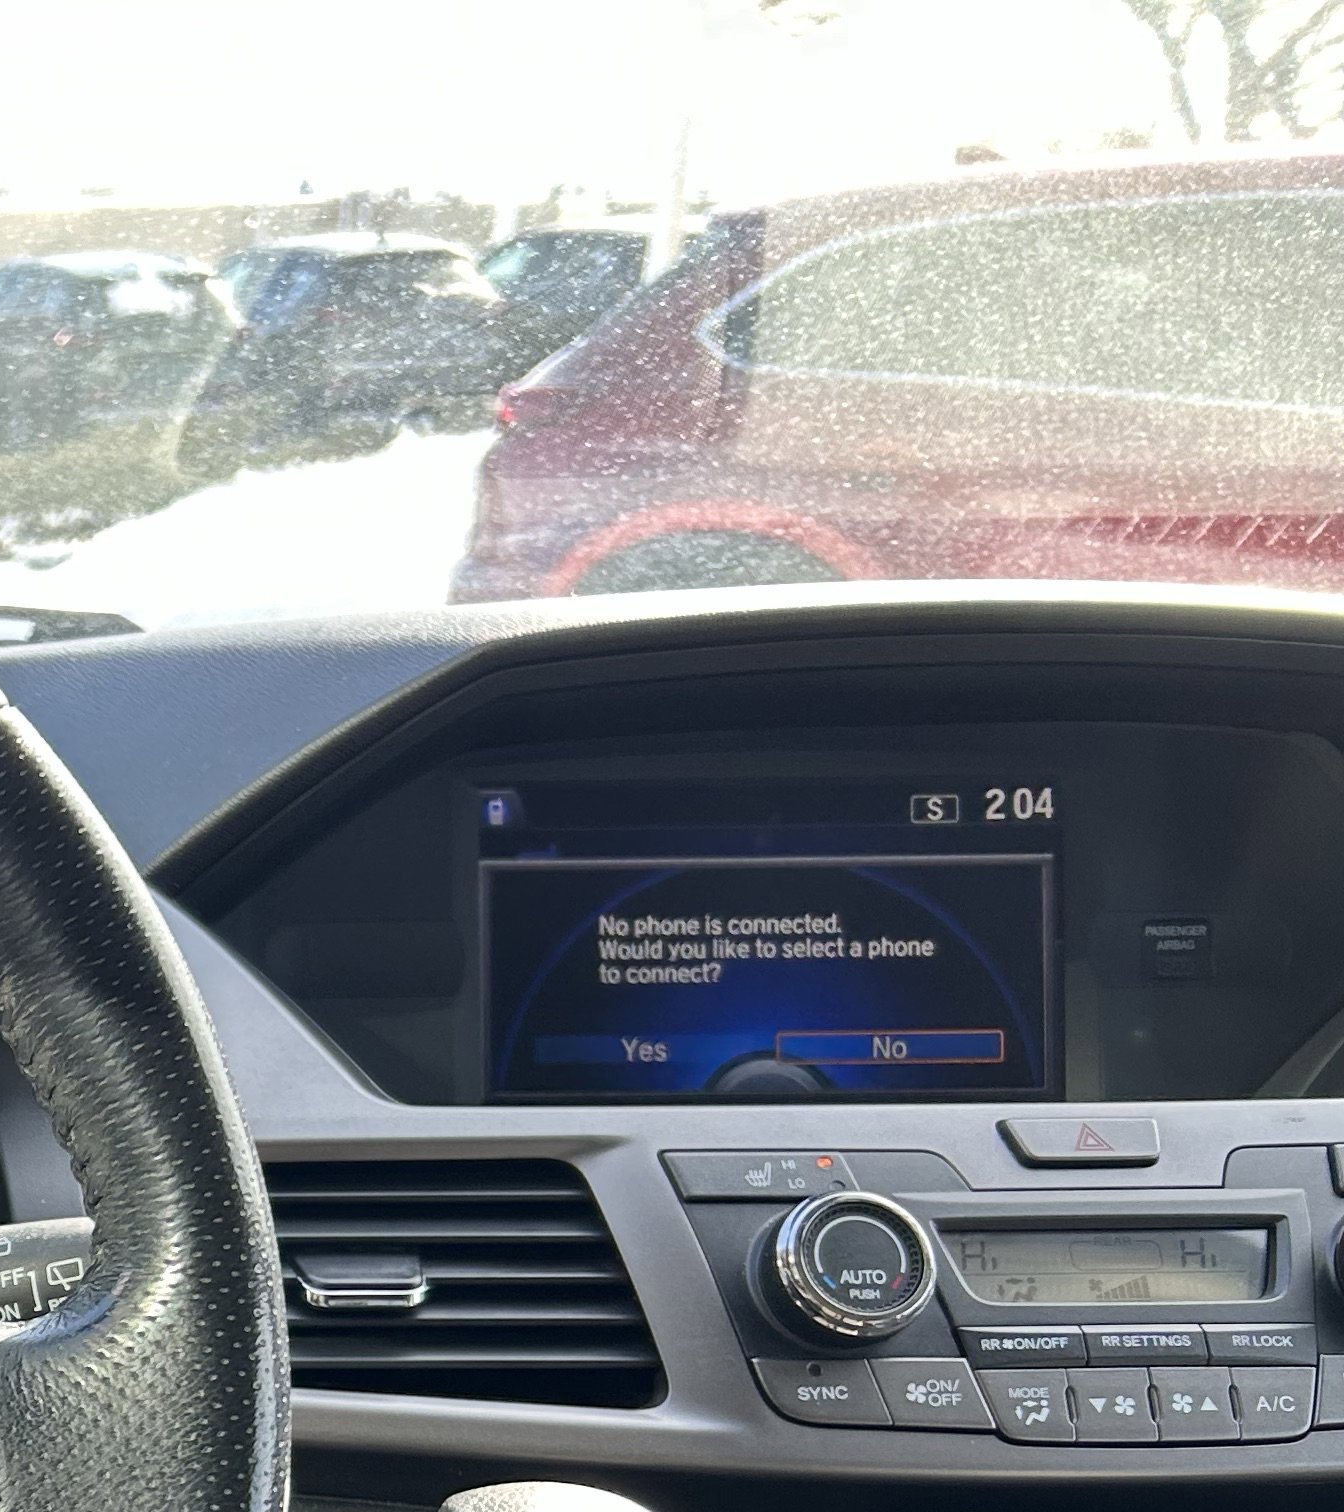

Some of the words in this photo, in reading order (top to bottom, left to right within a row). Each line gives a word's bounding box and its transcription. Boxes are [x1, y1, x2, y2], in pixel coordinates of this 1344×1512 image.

[598, 914, 629, 936] No
[634, 914, 701, 938] phone
[705, 913, 722, 935] is
[728, 912, 843, 936] connected.
[1145, 926, 1208, 936] PASSENGER
[599, 938, 663, 961] Would
[667, 942, 707, 962] you
[713, 937, 750, 959] like
[754, 938, 777, 959] to
[782, 937, 845, 959] select
[849, 942, 862, 958] a
[868, 936, 935, 960] phone
[599, 963, 621, 984] to
[625, 963, 722, 984] connect?
[621, 1036, 669, 1063] Yes
[872, 1035, 908, 1060] No
[781, 1159, 797, 1170] HI
[788, 1178, 806, 1190] LO
[840, 1269, 888, 1285] AUTO
[849, 1288, 881, 1300] PUSH
[980, 1337, 1002, 1351] RR
[1014, 1336, 1069, 1351] ON/OFF
[1101, 1335, 1122, 1347] RR
[1122, 1334, 1192, 1348] SETTINGS
[1232, 1334, 1251, 1347] RR
[1251, 1334, 1294, 1348] LOCK
[926, 1379, 960, 1393] ON/
[1008, 1387, 1050, 1399] MODE
[797, 1385, 849, 1402] SYNC
[928, 1393, 962, 1407] OFF
[1256, 1395, 1296, 1413] A/C
